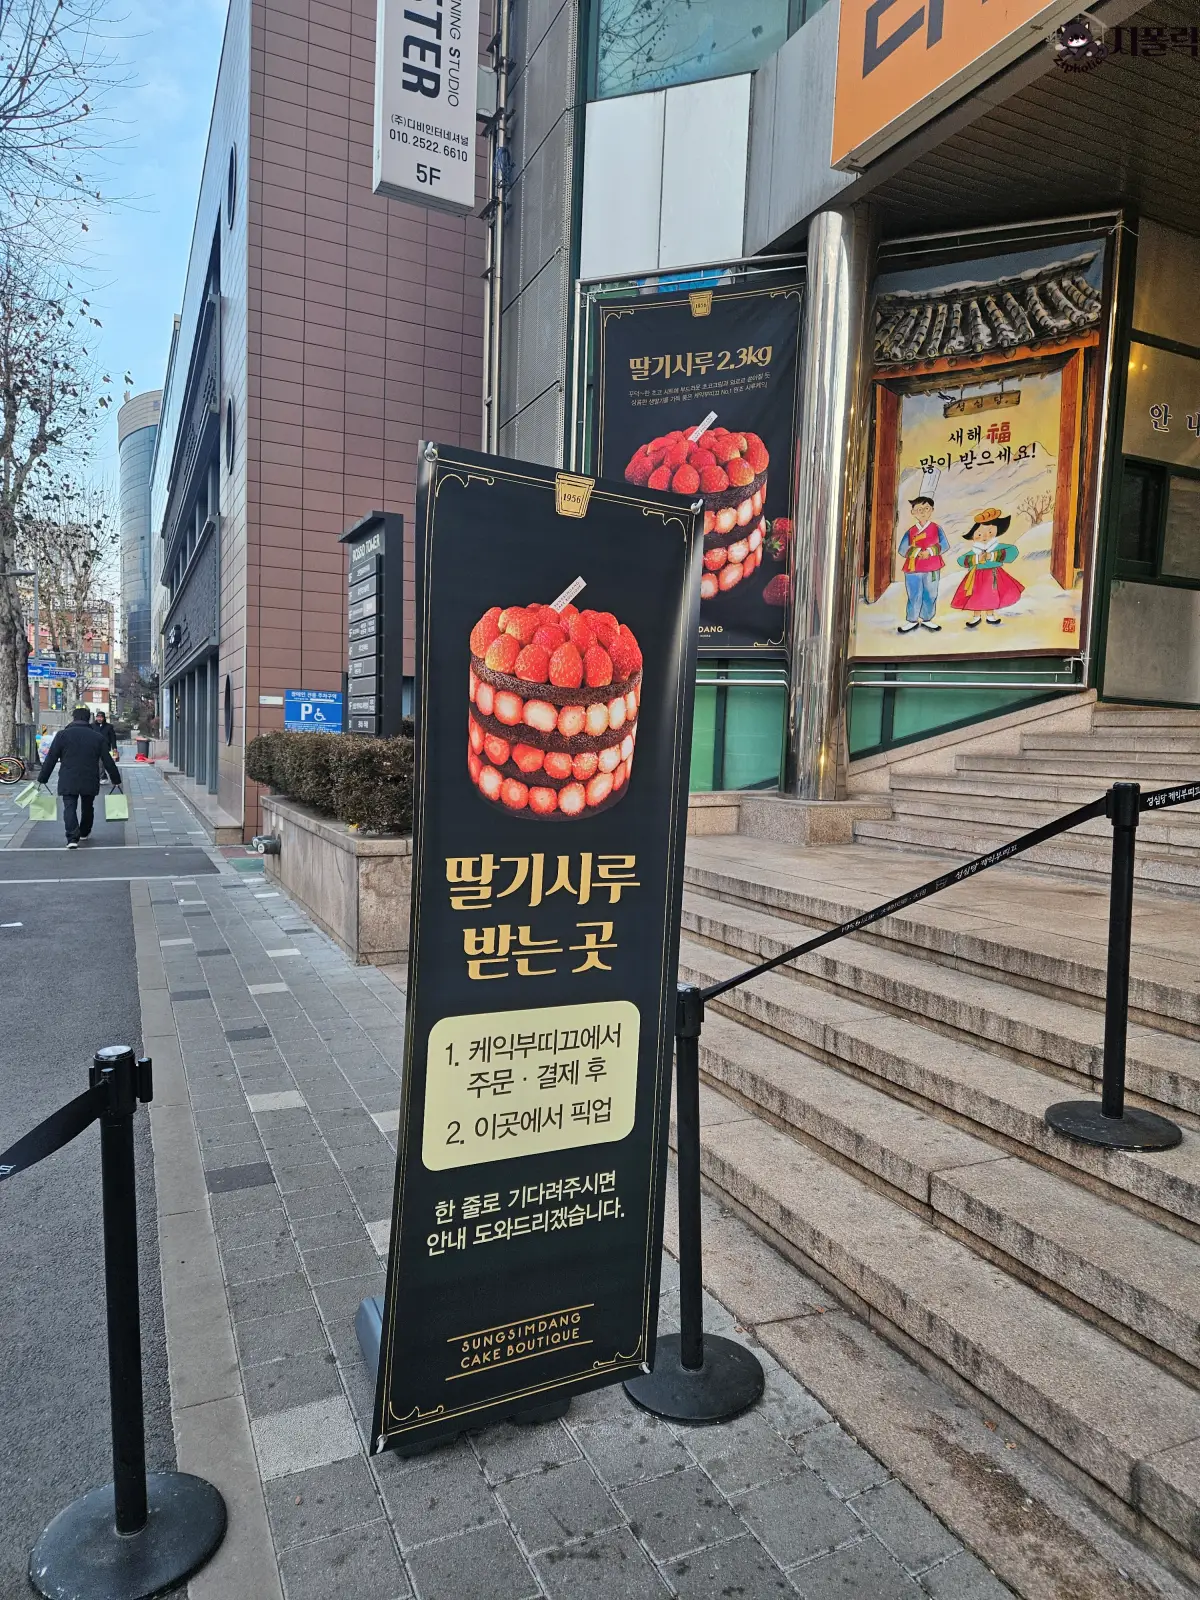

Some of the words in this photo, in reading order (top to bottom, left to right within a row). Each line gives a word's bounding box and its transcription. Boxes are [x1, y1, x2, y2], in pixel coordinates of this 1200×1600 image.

[402, 0, 442, 98] TER
[448, 47, 460, 107] STUDIO
[391, 114, 469, 146] (주)디비인터네셔널
[416, 163, 441, 185] 5F
[629, 351, 714, 381] 딸기시루
[716, 345, 773, 371] 2.3kg
[948, 425, 981, 447] 새해
[986, 422, 1011, 444] 福
[919, 452, 951, 475] 많이
[959, 442, 1036, 469] 받으세요!
[563, 493, 581, 504] 1956
[301, 703, 312, 721] P
[1146, 793, 1168, 807] 성심당
[445, 853, 641, 911] 딸기시루
[463, 924, 563, 980] 받는
[569, 921, 618, 973] 곳
[445, 1043, 460, 1067] 1.
[468, 1022, 622, 1063] 케익부띠끄에서
[466, 1068, 515, 1099] 주문
[536, 1059, 580, 1091] 결제
[585, 1056, 608, 1083] 후
[445, 1121, 465, 1146] 2.
[474, 1103, 564, 1141] 이곳에서
[570, 1097, 613, 1126] 픽업
[434, 1199, 456, 1225] 한
[461, 1192, 502, 1220] 줄로
[508, 1170, 616, 1210] 기다려주시면
[426, 1226, 467, 1256] 안내
[472, 1197, 626, 1246] 도와드리겠습니다.
[460, 1348, 501, 1369] CAKE
[506, 1328, 580, 1357] BOUTIQUE
[461, 1312, 581, 1353] SUNGSIMDANG
